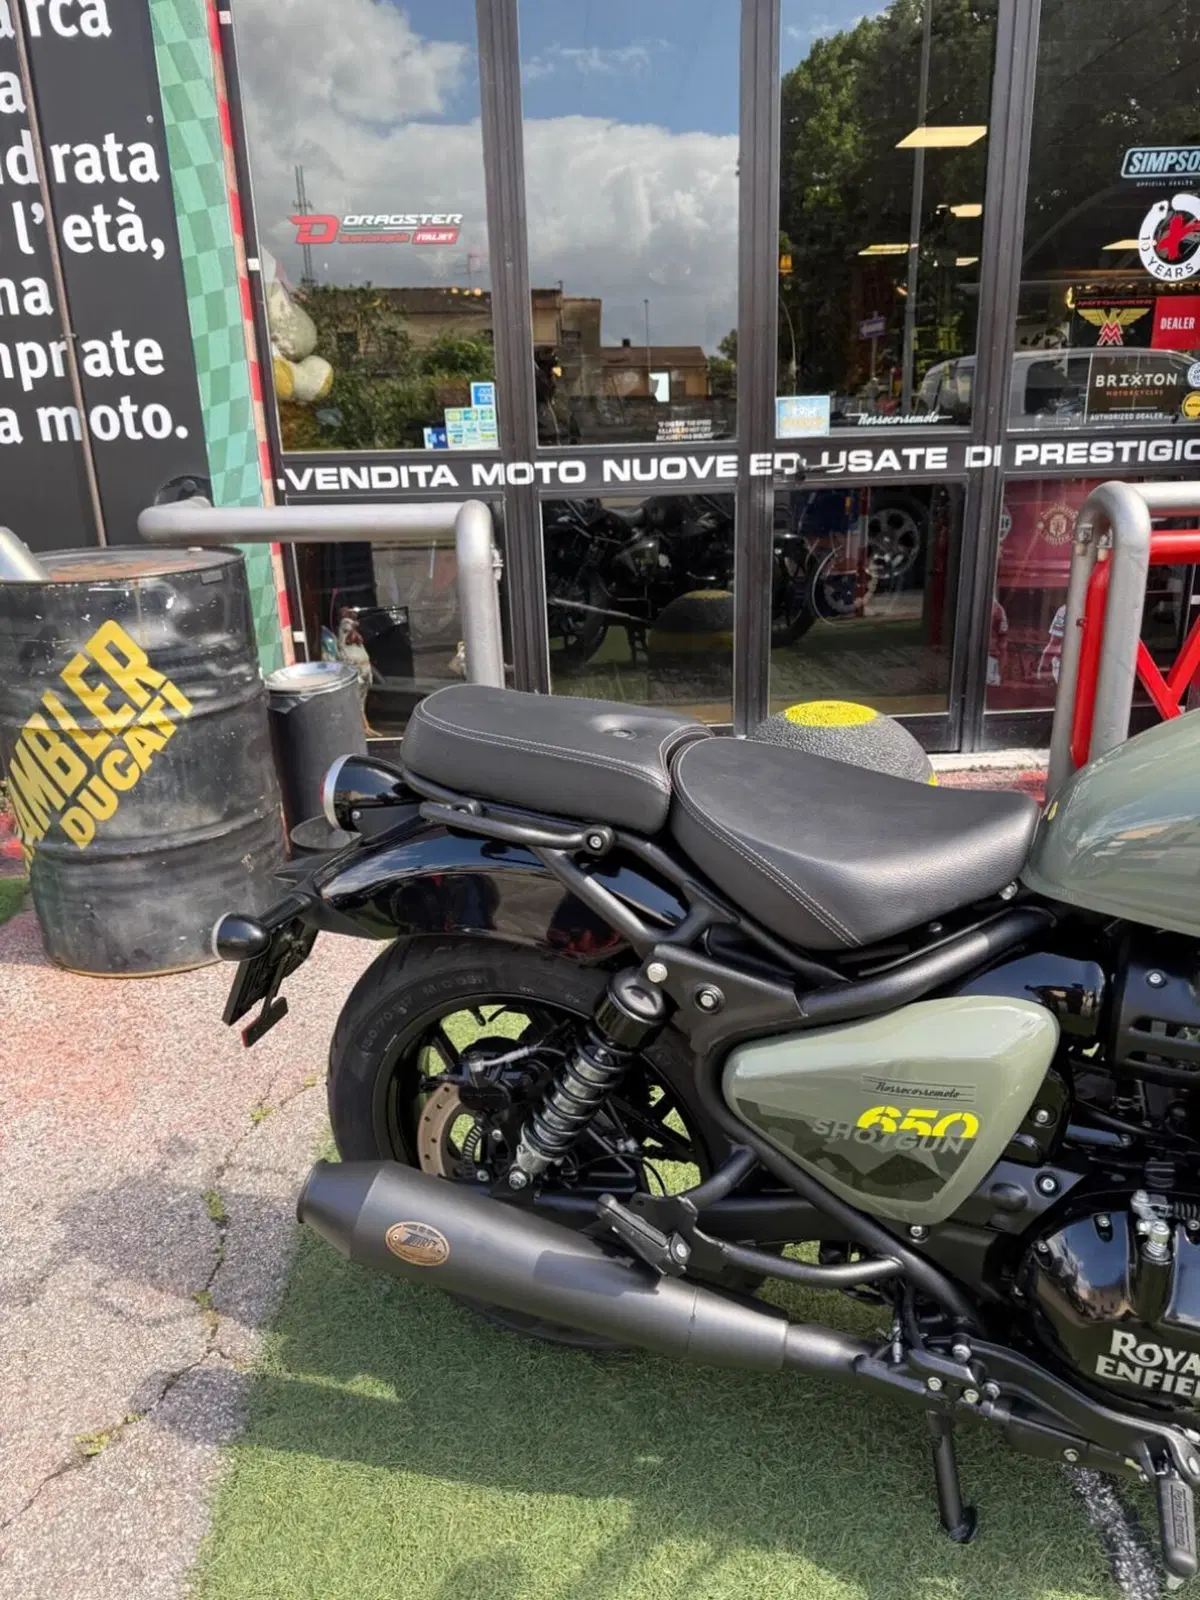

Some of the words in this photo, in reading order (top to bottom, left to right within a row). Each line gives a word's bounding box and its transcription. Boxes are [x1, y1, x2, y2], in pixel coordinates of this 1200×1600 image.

[0, 129, 160, 185] drata
[1128, 151, 1200, 174] SIMPSO
[343, 213, 463, 225] DRAGSTER
[1147, 256, 1195, 279] YEARS
[1160, 317, 1196, 330] DEALER
[1095, 373, 1178, 388] BRIXTON
[36, 395, 189, 442] moto.
[472, 460, 586, 487] MOTO
[602, 455, 739, 483] NUOVE
[749, 452, 801, 476] ED
[821, 447, 948, 474] USATE
[964, 445, 1002, 469] DI
[59, 680, 193, 850] DUCATI
[812, 1117, 964, 1155] SHOTGUN
[857, 1105, 979, 1138] 650
